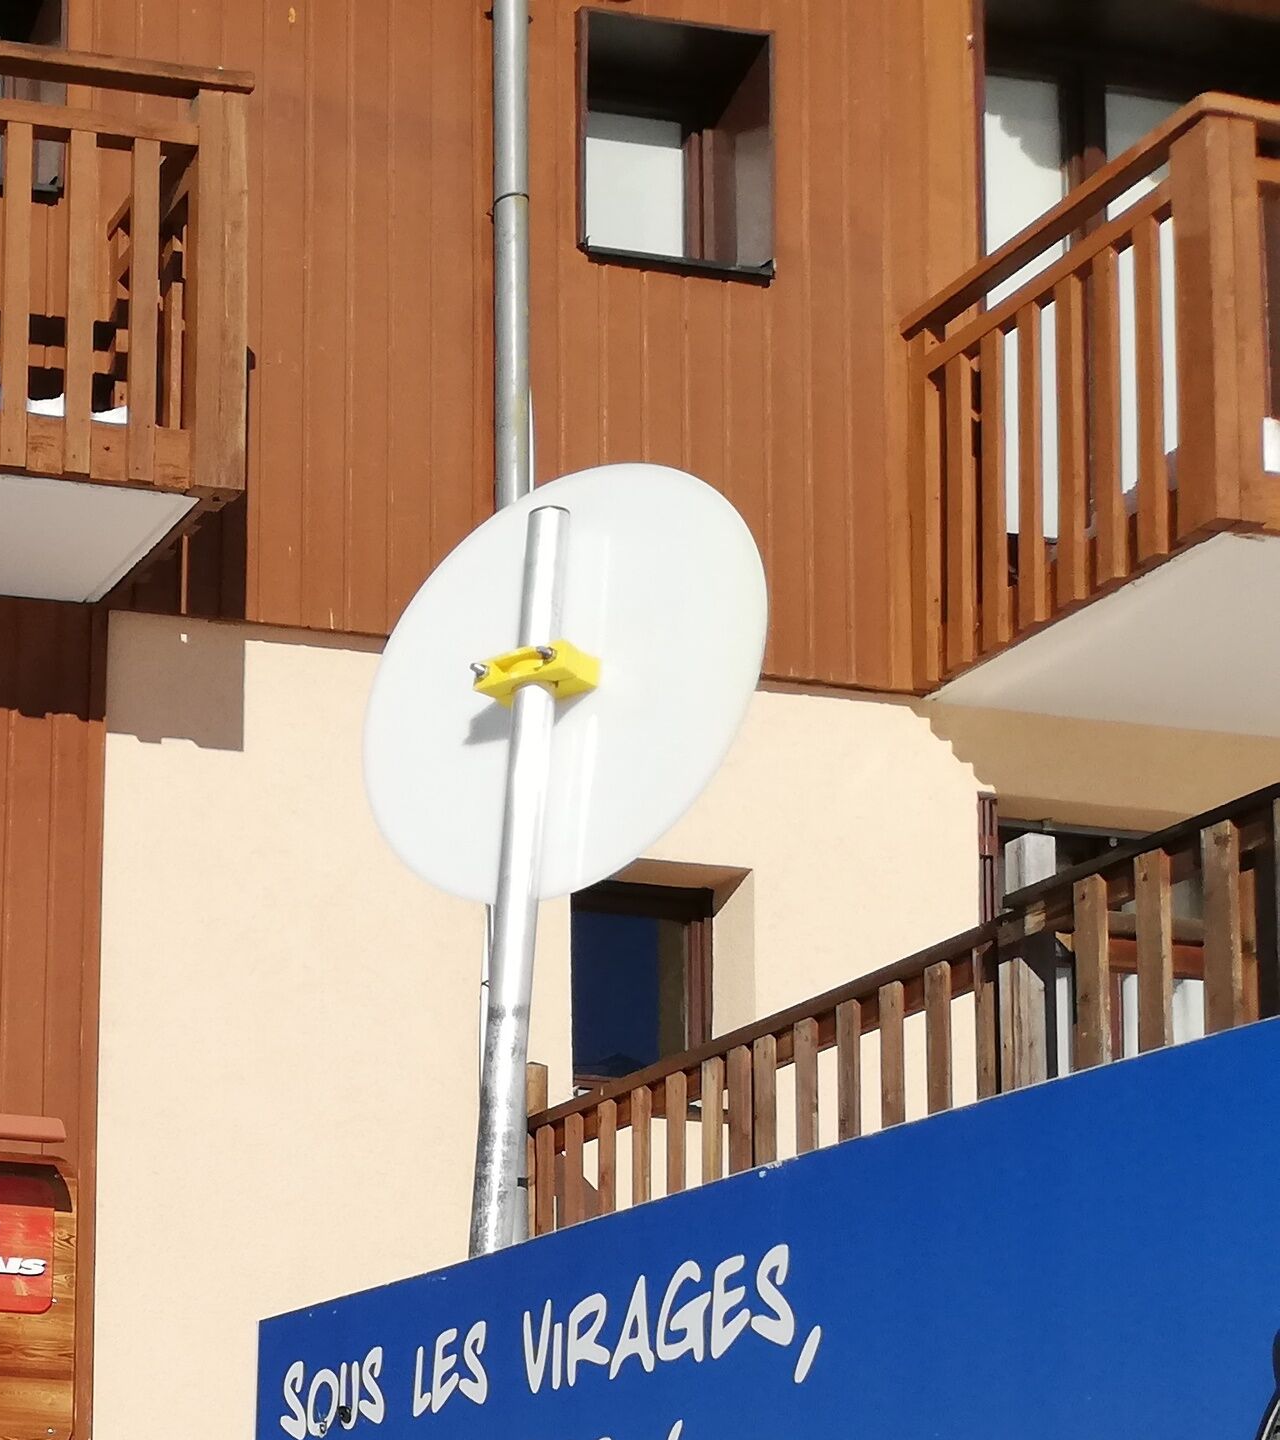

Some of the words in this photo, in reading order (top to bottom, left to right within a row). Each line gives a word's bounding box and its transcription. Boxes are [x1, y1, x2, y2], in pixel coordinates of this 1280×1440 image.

[280, 1346, 385, 1440] SOUS
[413, 1320, 489, 1418] LES
[522, 1243, 823, 1395] VIRAGES,
